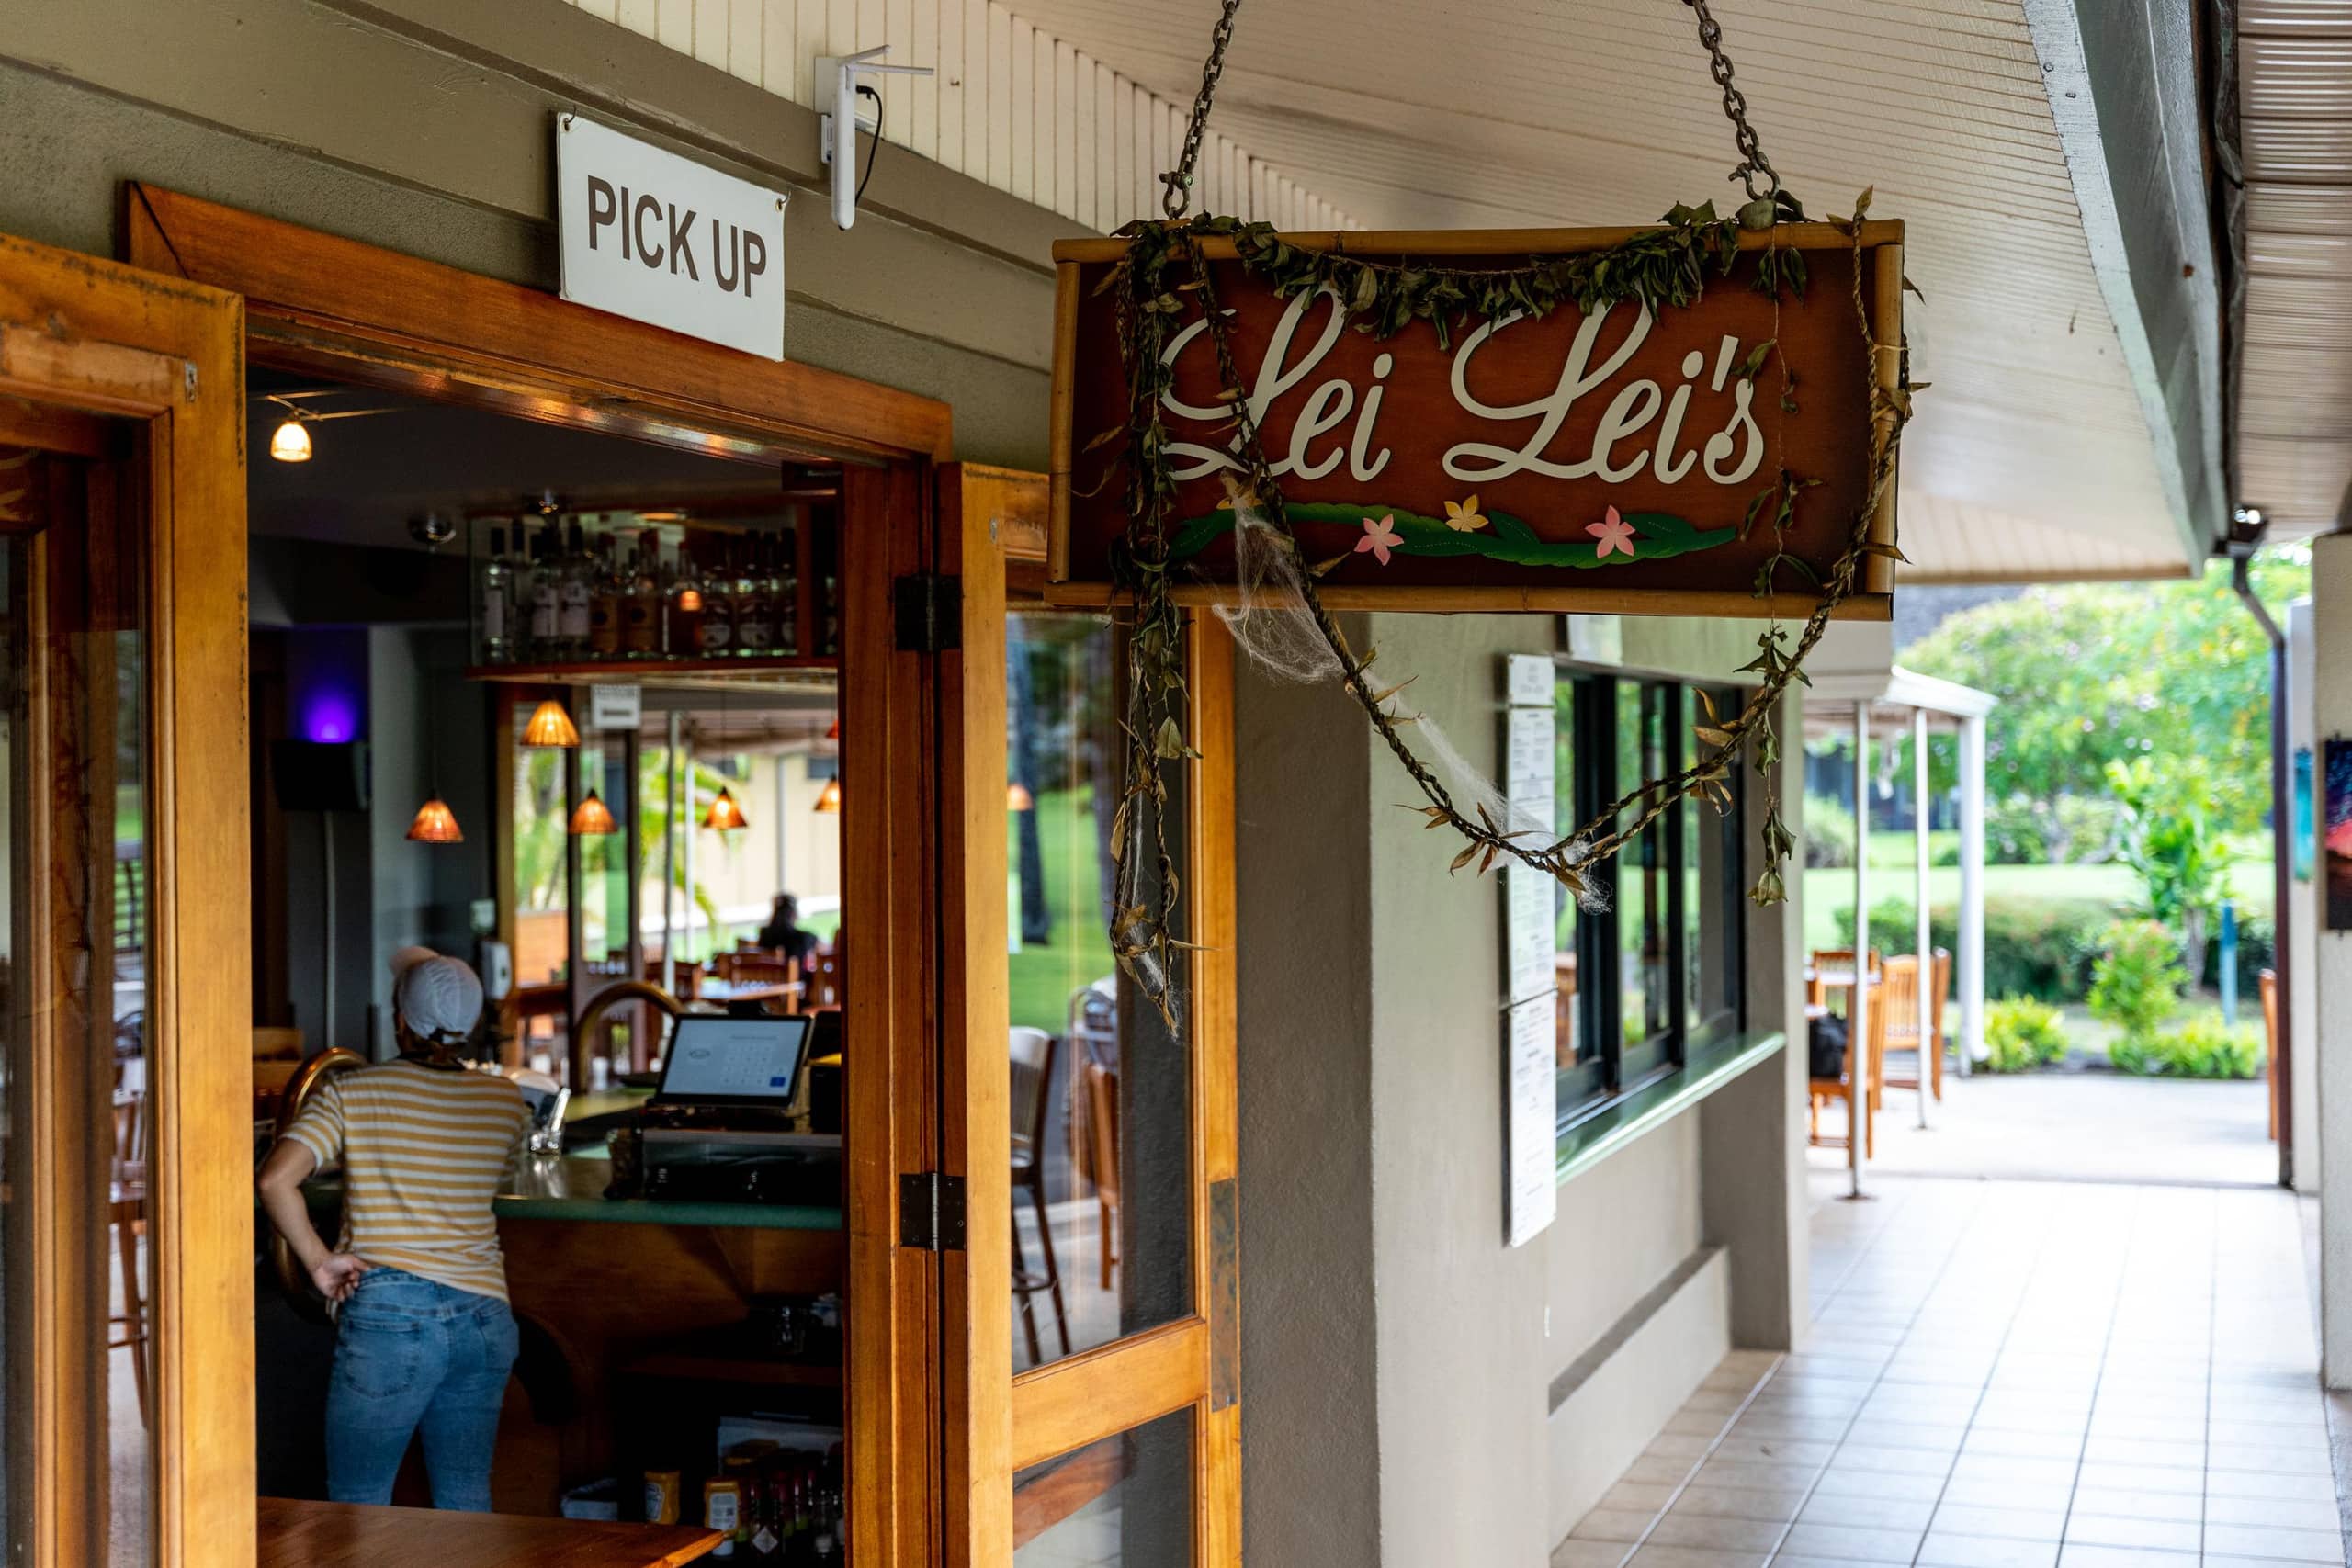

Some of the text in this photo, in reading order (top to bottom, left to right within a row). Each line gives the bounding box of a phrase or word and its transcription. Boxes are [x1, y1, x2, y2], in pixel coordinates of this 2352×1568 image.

[587, 175, 767, 299] PICK UP
[1158, 279, 1765, 485] Lei Lei's
